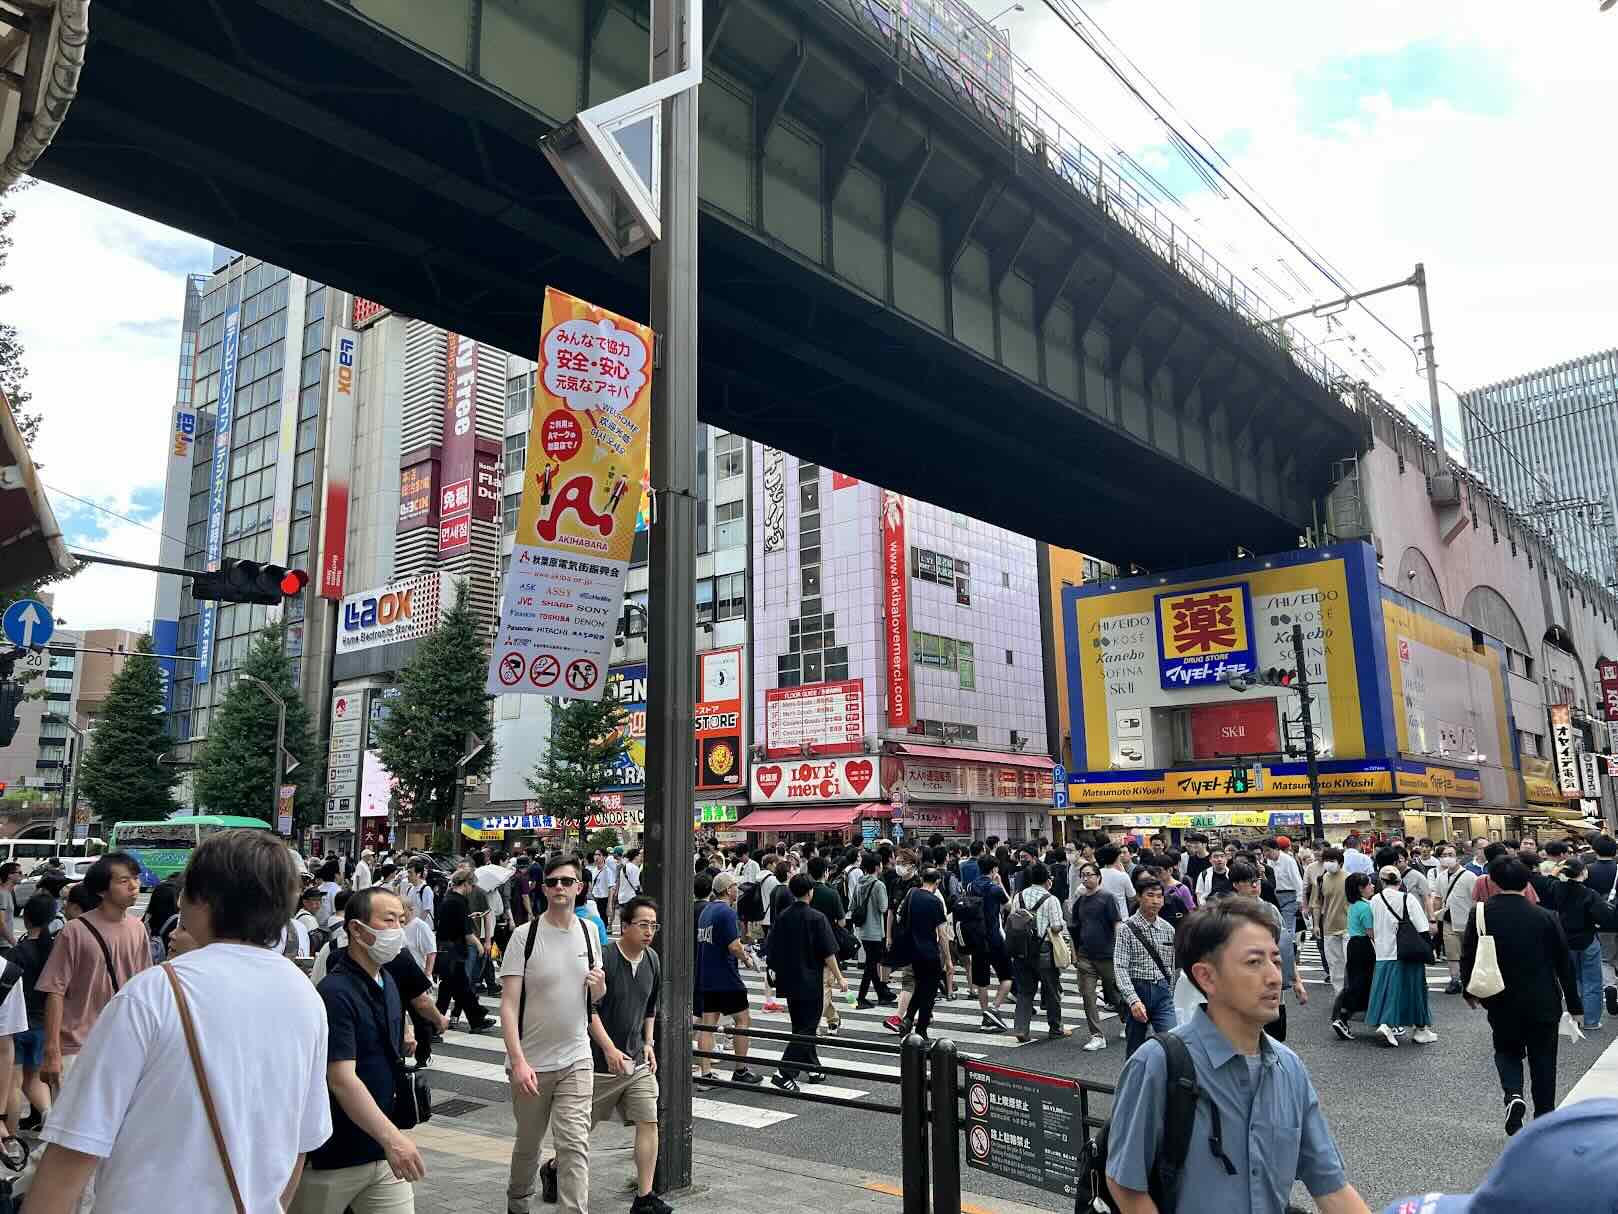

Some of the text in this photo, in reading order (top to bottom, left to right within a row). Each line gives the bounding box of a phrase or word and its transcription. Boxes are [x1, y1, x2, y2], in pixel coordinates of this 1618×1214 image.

[556, 329, 631, 357] みんなで協力
[556, 350, 630, 380] 安全・安心
[556, 374, 629, 399] 元気なアキバ
[455, 370, 474, 435] Free
[558, 535, 608, 551] AKIHABARA
[518, 597, 609, 616] JVC SHARP SONY
[1264, 591, 1338, 609] SHISEIDO
[539, 613, 570, 623] TOSHIBA
[574, 617, 605, 628] DENON
[888, 541, 904, 717] www.akibalovemerci.com
[1088, 617, 1150, 634] SHISEIDO
[1171, 594, 1238, 653] 薬
[536, 626, 569, 637] HITACHI
[1273, 626, 1334, 644] Kaebo
[1096, 649, 1146, 664] Kanebo
[1183, 653, 1230, 664] DRUG STORE
[1279, 643, 1336, 660] SOINA
[27, 655, 42, 667] 20
[791, 763, 834, 782] LOVE
[1082, 787, 1132, 798] Matsumoto
[1190, 816, 1213, 827] SALE
